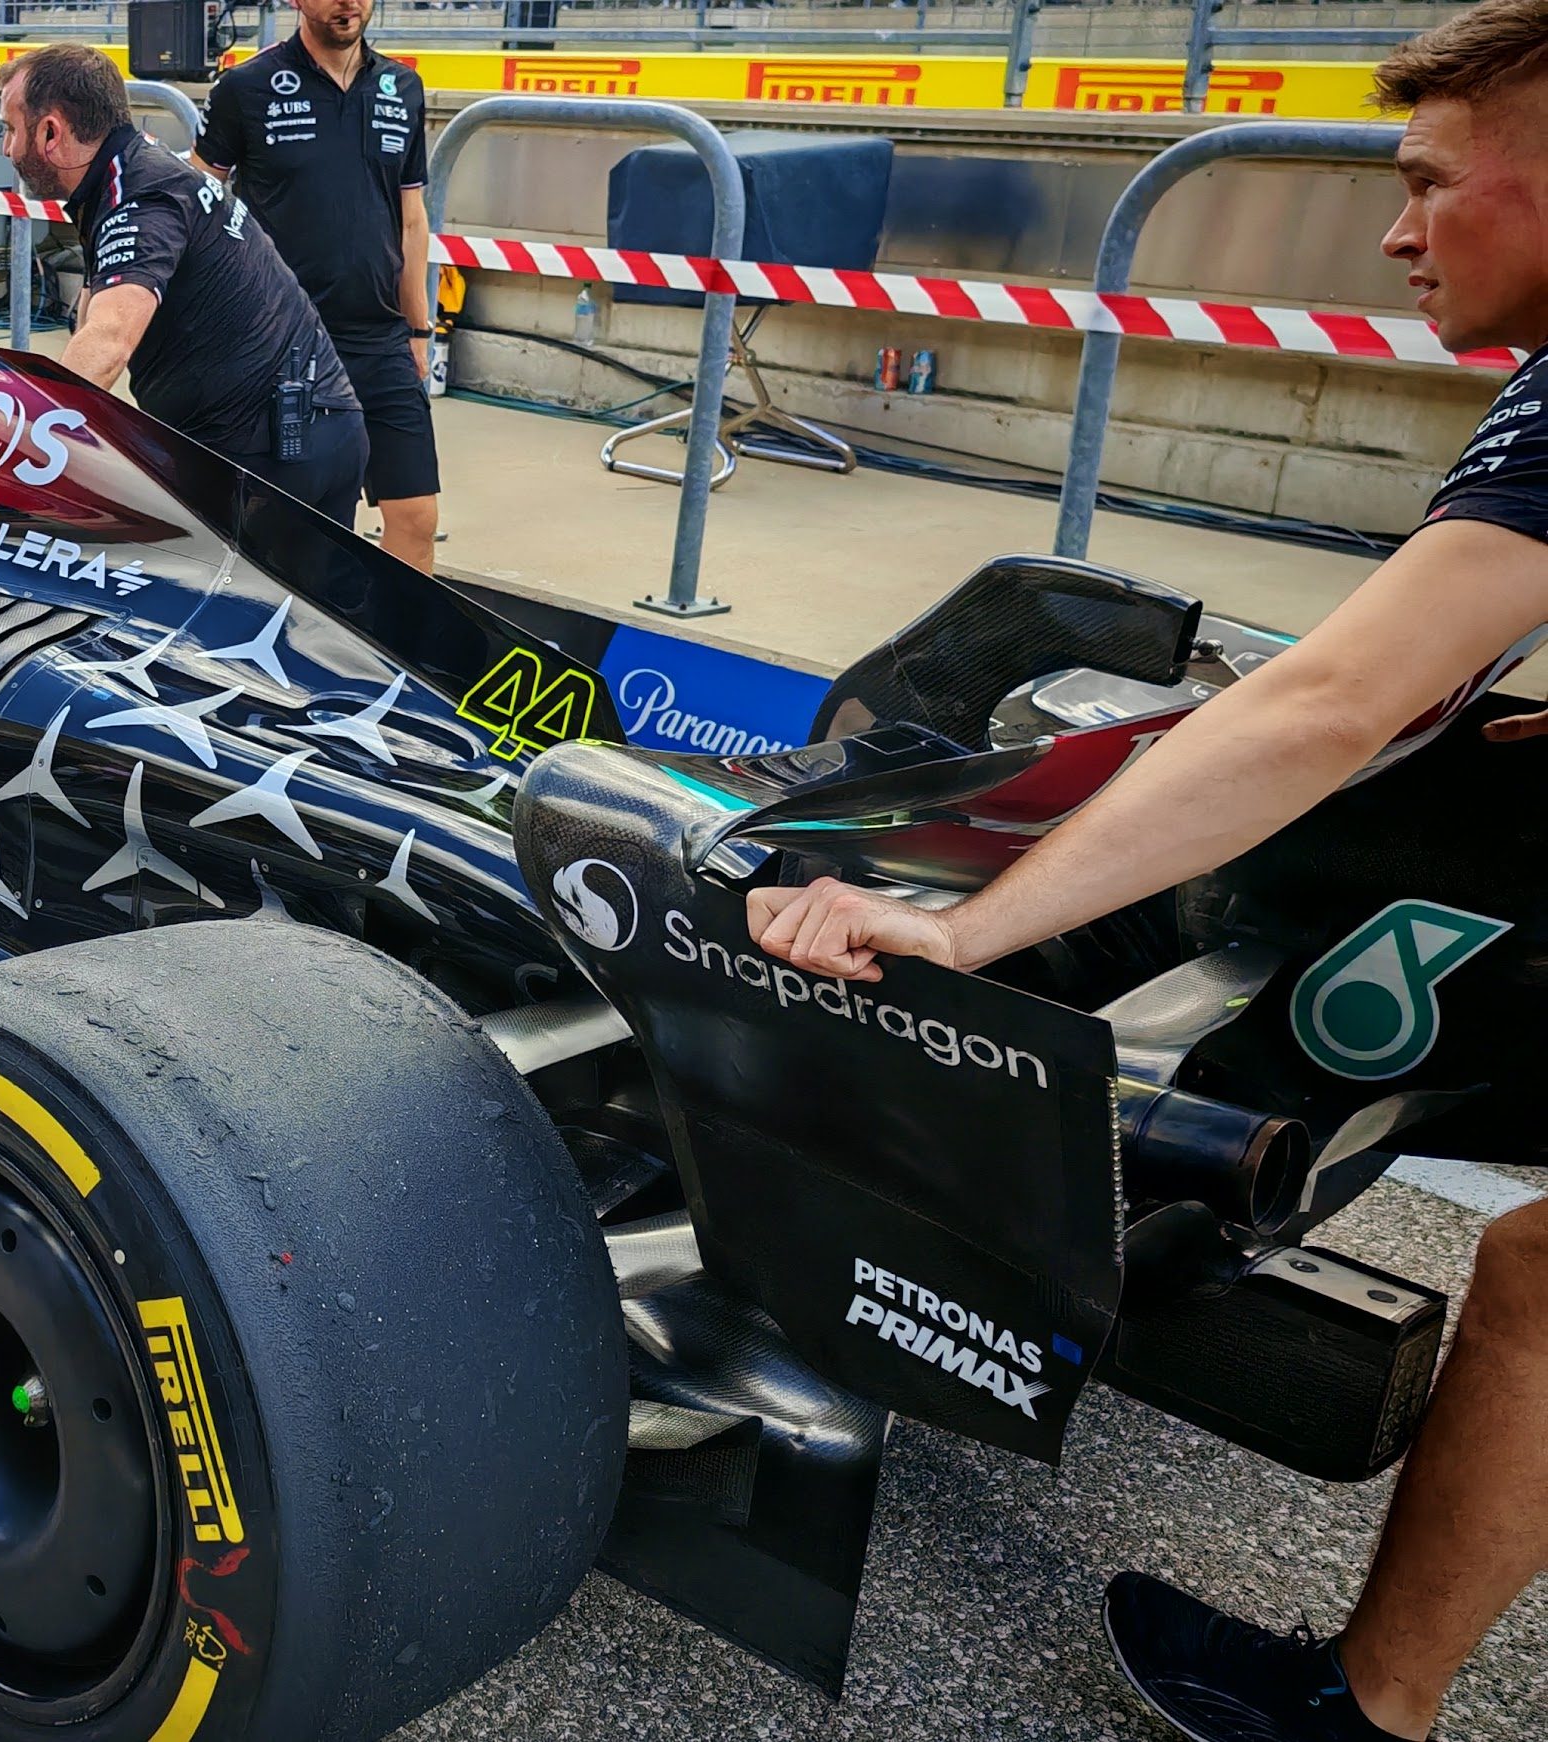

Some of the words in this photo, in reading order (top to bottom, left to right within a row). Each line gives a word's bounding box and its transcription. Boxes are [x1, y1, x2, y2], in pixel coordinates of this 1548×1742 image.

[283, 100, 311, 114] UBS
[1055, 68, 1284, 113] PIRELI
[455, 647, 595, 762] 44
[664, 909, 1049, 1089] Snapdragon
[845, 1294, 1053, 1421] PRIMAX
[854, 1257, 1043, 1373] PETRONAS
[137, 1296, 245, 1543] PIRELLI
